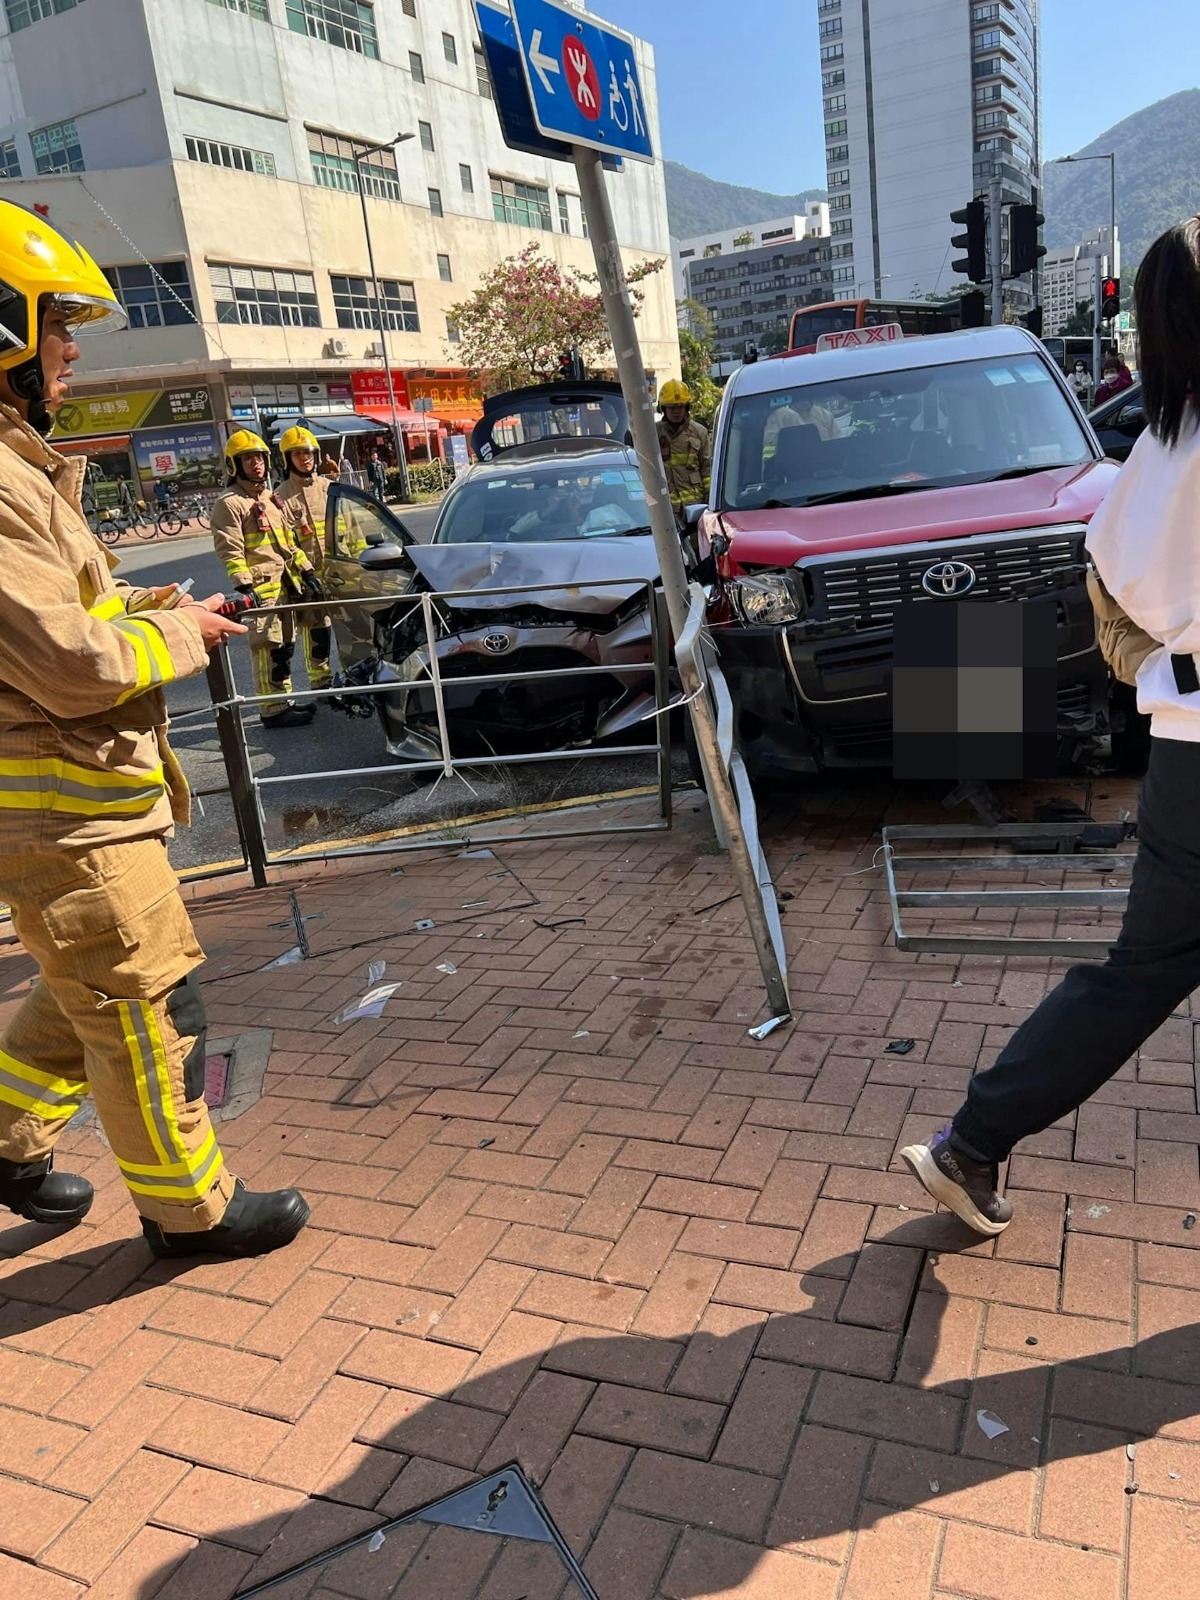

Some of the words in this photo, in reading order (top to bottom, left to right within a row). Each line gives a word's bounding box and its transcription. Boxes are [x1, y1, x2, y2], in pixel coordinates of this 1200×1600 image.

[825, 324, 896, 350] TAXI
[89, 399, 130, 416] 學車易
[155, 455, 175, 475] 學
